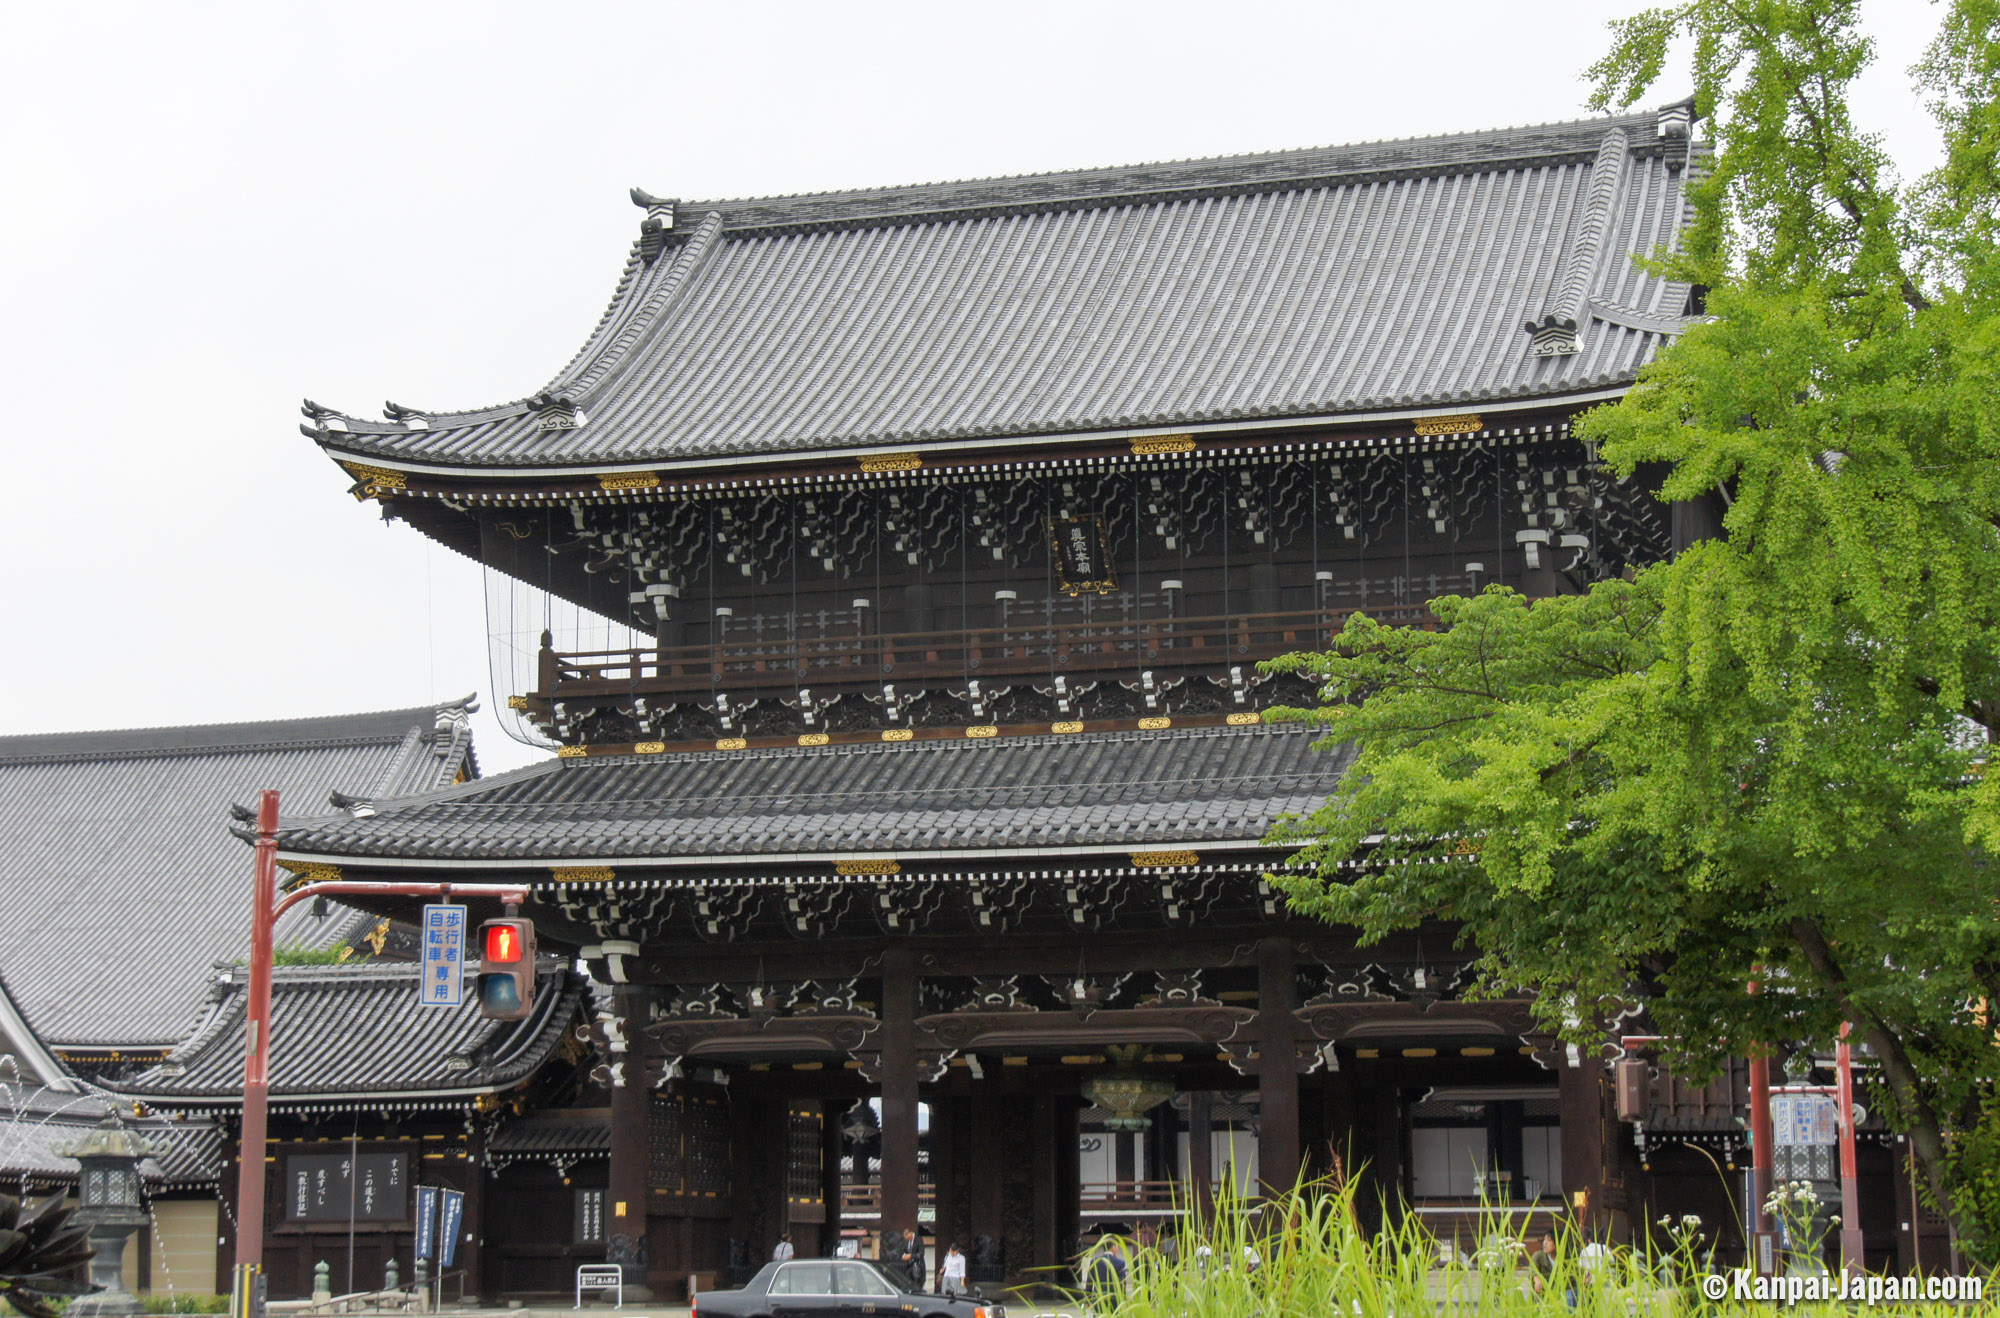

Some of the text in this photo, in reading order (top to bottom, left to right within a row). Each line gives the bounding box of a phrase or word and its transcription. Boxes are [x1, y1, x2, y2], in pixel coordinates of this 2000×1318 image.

[428, 912, 444, 962] 自転車
[444, 912, 461, 962] 歩行者
[434, 966, 450, 999] 専用
[1779, 1101, 1789, 1141] 押ボタン式
[341, 1160, 351, 1179] 必ず
[390, 1158, 398, 1185] すでに
[364, 1169, 374, 1214] この道あり
